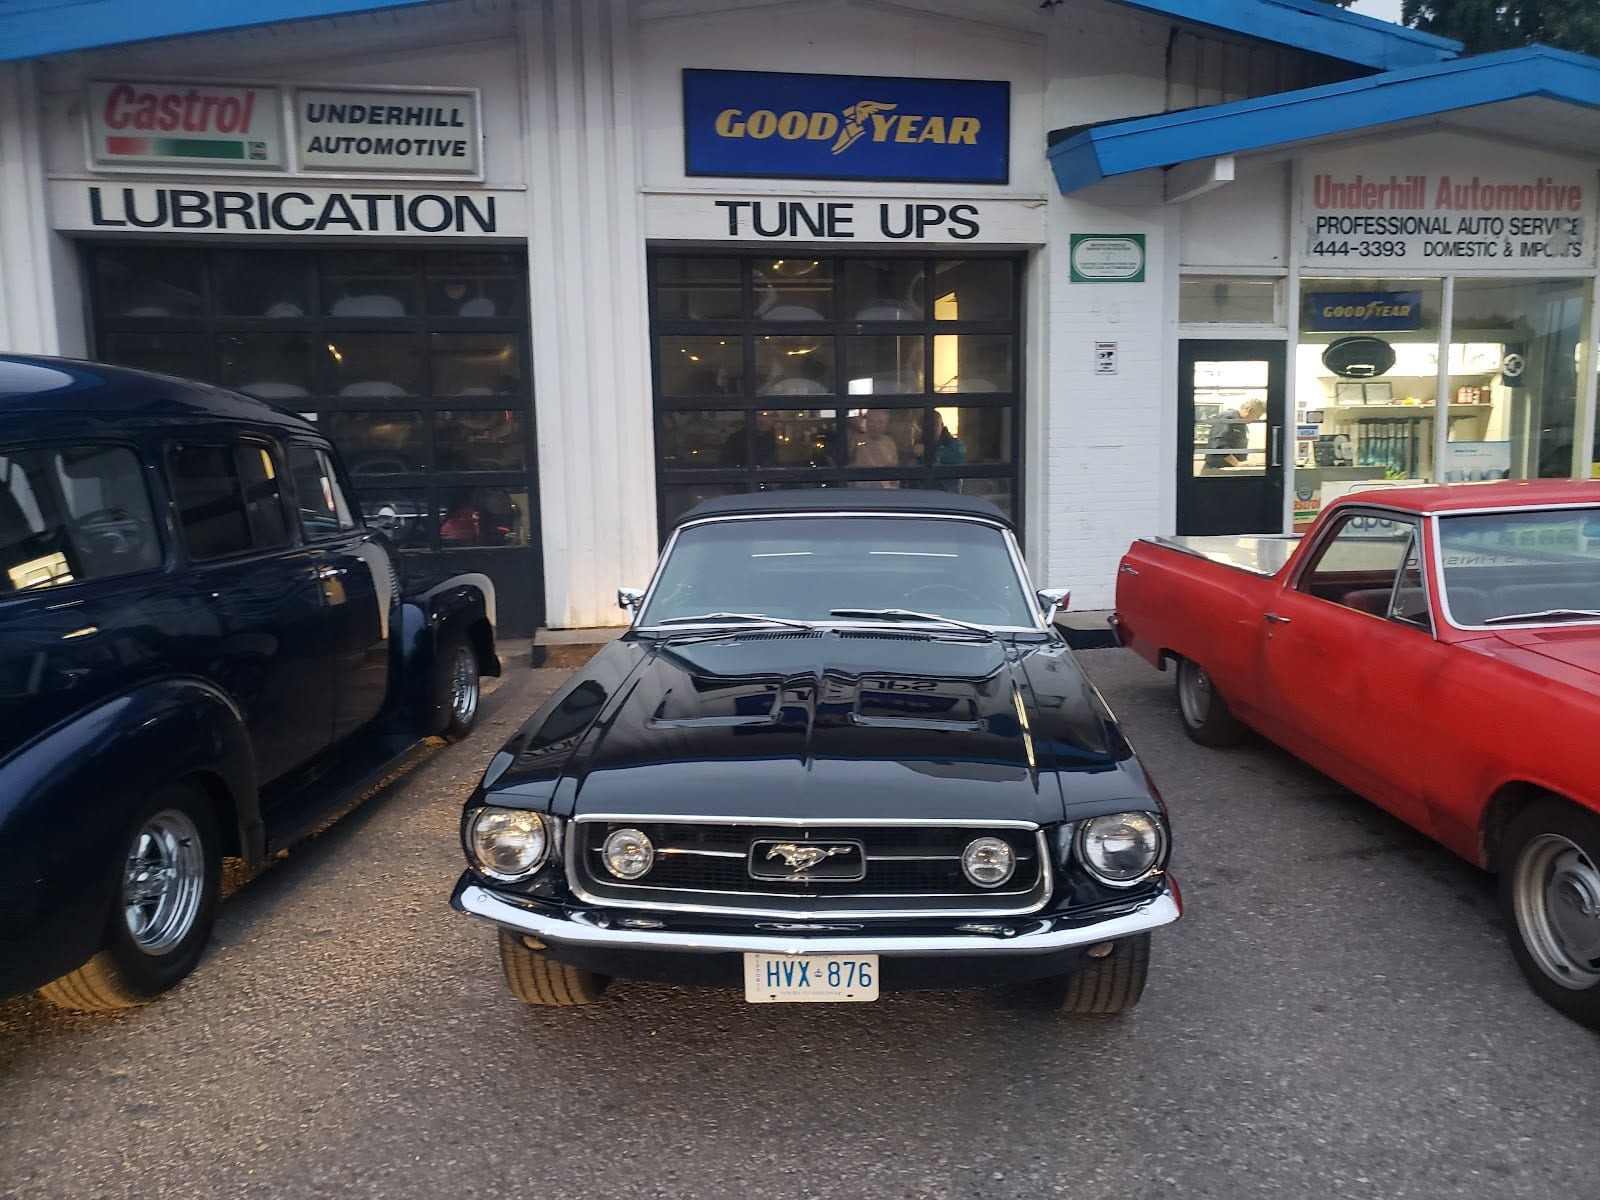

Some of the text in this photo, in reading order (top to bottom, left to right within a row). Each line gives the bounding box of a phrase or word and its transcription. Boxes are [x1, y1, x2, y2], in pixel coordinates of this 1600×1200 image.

[105, 83, 255, 134] Castrol
[306, 103, 464, 128] UNDERHILL
[306, 136, 467, 157] AUTOMOTIVE
[1313, 174, 1582, 212] Underhill Automotive
[88, 187, 497, 233] LUBRICATION
[715, 200, 980, 240] TUNE UPS
[1316, 216, 1452, 235] PROFESSIONAL
[1456, 216, 1504, 235] AUTO
[1312, 241, 1582, 258] 444-3393 DOMESTIC & IMPOTS
[766, 960, 810, 988] HVX
[827, 961, 872, 988] 876
